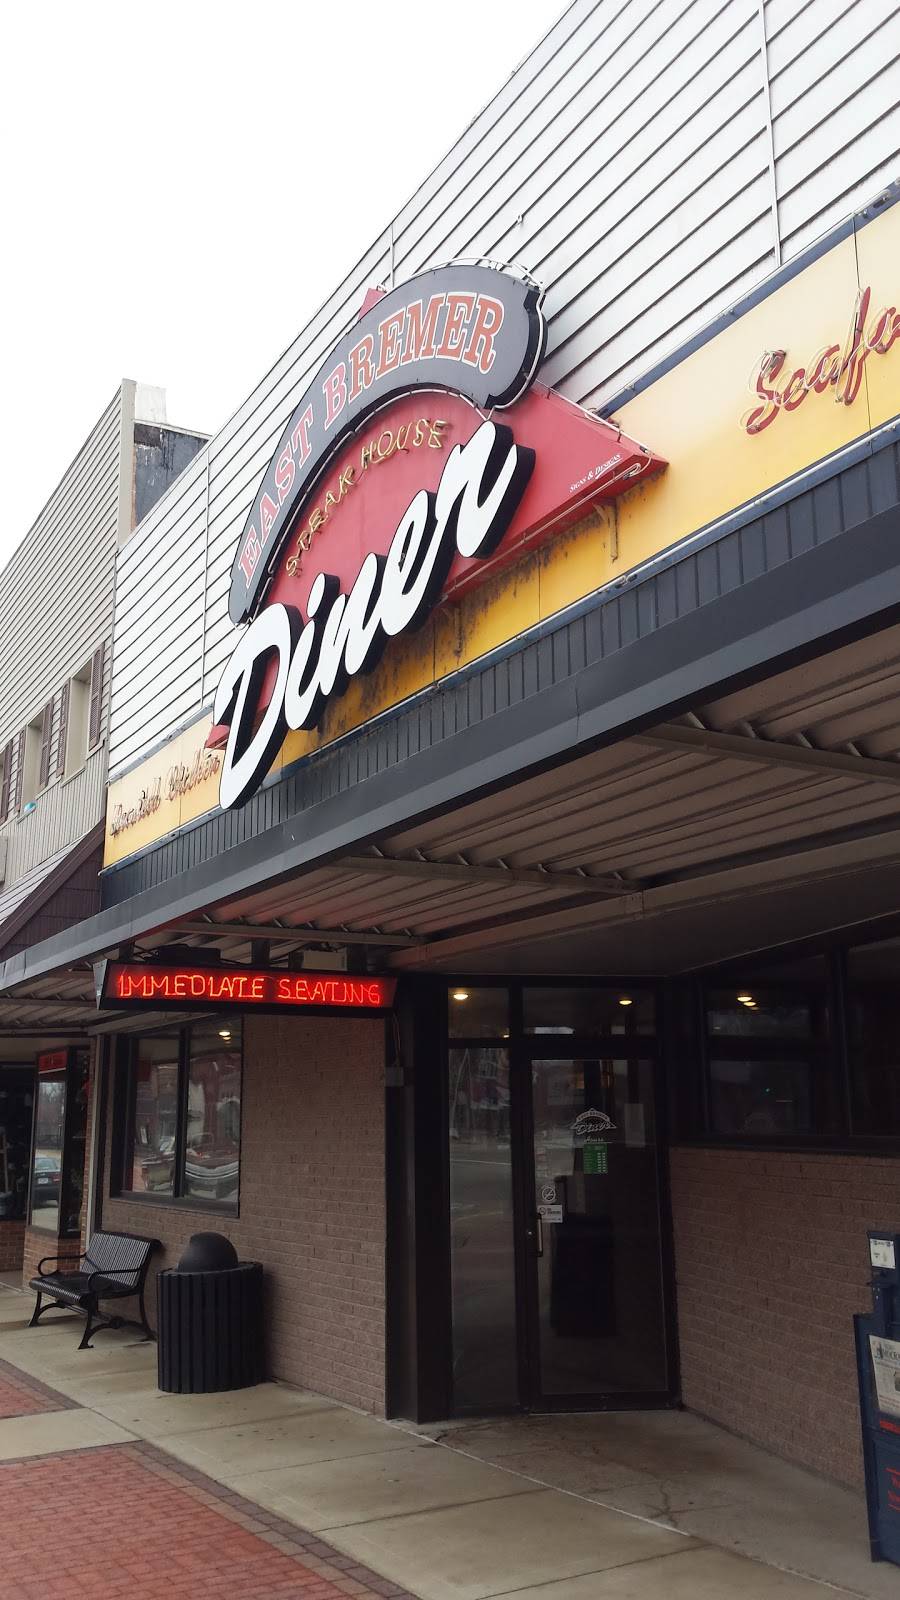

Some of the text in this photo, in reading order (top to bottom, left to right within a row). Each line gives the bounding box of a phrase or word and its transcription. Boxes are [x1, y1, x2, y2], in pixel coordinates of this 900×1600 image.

[236, 290, 507, 590] EAST BREMER
[360, 417, 451, 471] HOUSE
[213, 419, 520, 810] Diner
[118, 973, 381, 1006] IMMEDIATE SEATING
